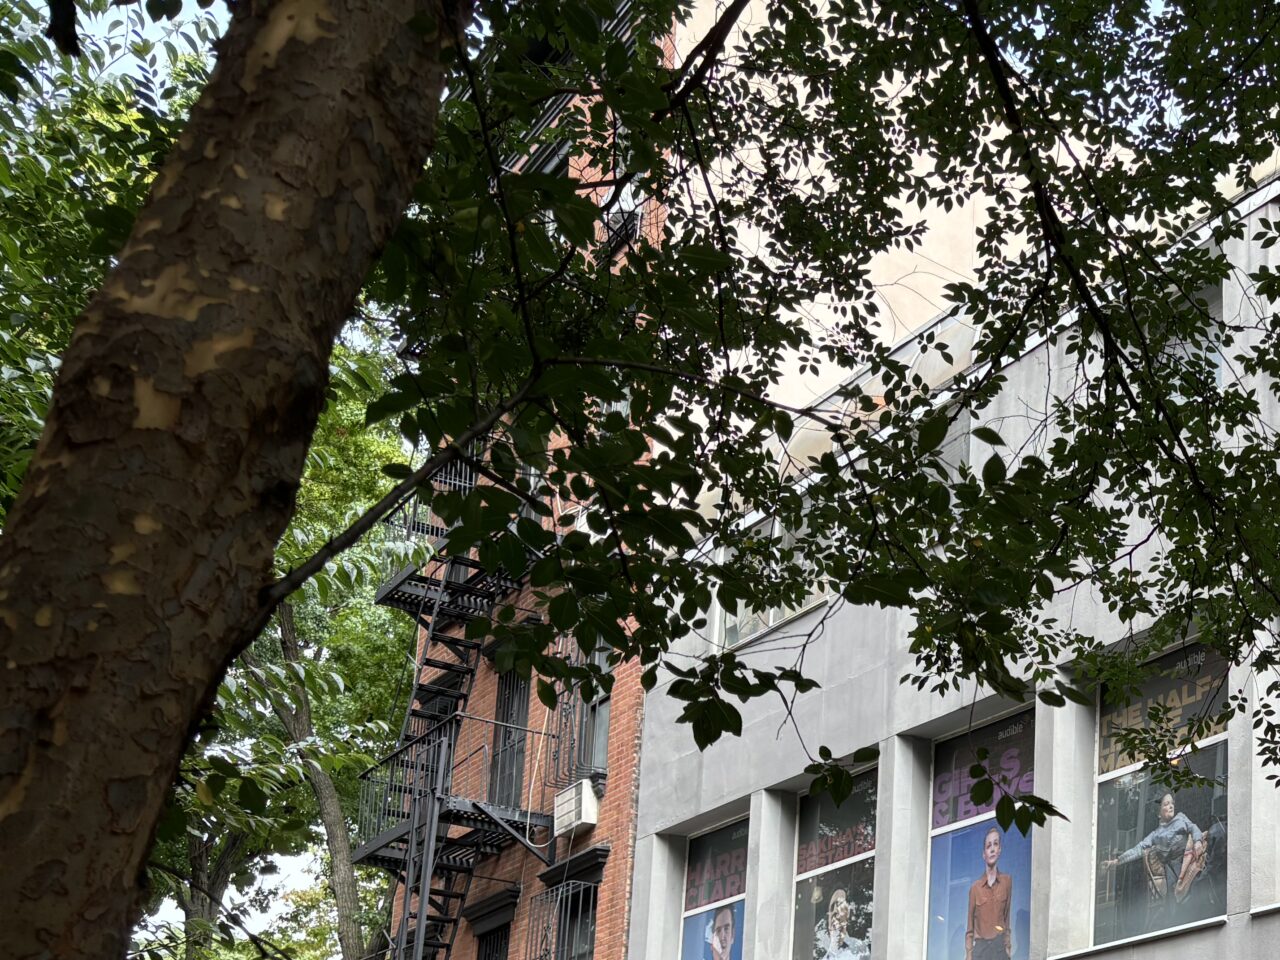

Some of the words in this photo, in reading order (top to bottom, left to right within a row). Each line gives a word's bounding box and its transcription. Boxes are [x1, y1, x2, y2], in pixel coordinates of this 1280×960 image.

[997, 722, 1023, 740] audible
[934, 748, 1020, 801] GIS
[687, 848, 747, 886] HARR
[686, 871, 746, 911] CLAR
